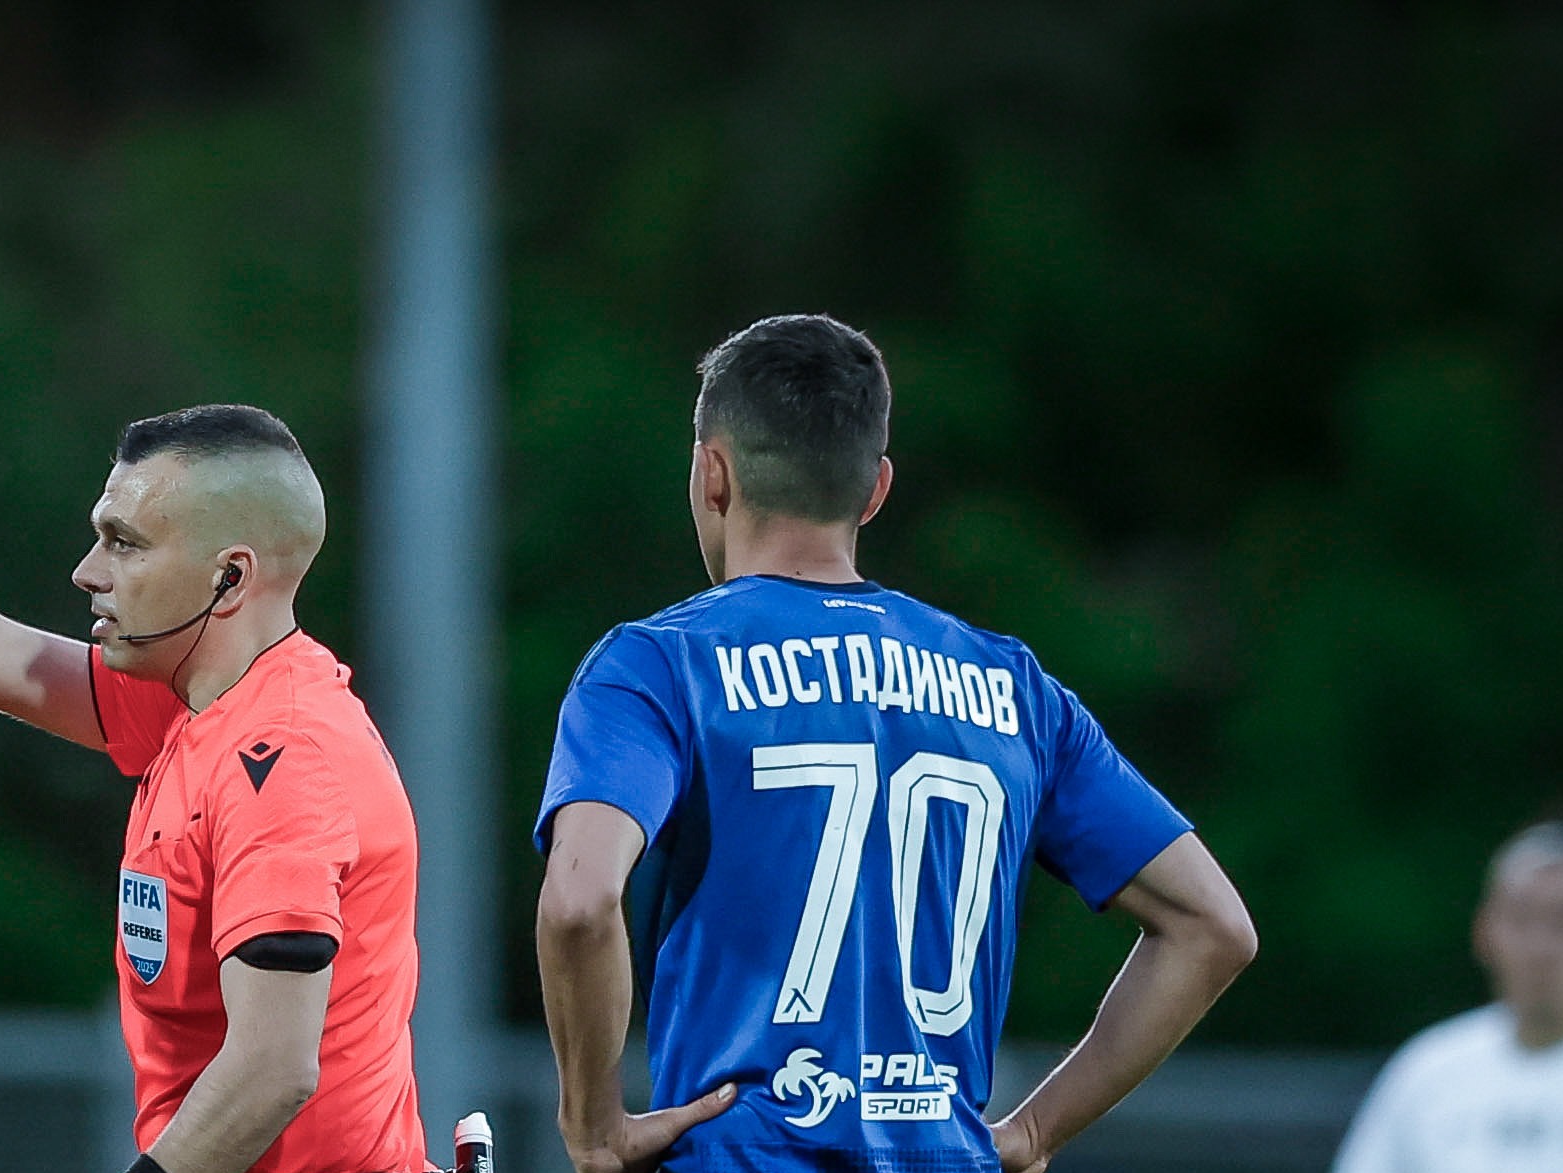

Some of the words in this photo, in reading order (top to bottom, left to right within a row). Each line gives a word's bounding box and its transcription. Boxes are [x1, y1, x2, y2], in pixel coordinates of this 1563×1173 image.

[715, 633, 1020, 736] КОСТАДИНОВ
[123, 878, 161, 912] FIFA
[752, 743, 1006, 1037] 70
[123, 921, 163, 943] REFEREE
[136, 959, 155, 975] 2025
[860, 1053, 959, 1095] PALS
[867, 1098, 941, 1115] SPORT
